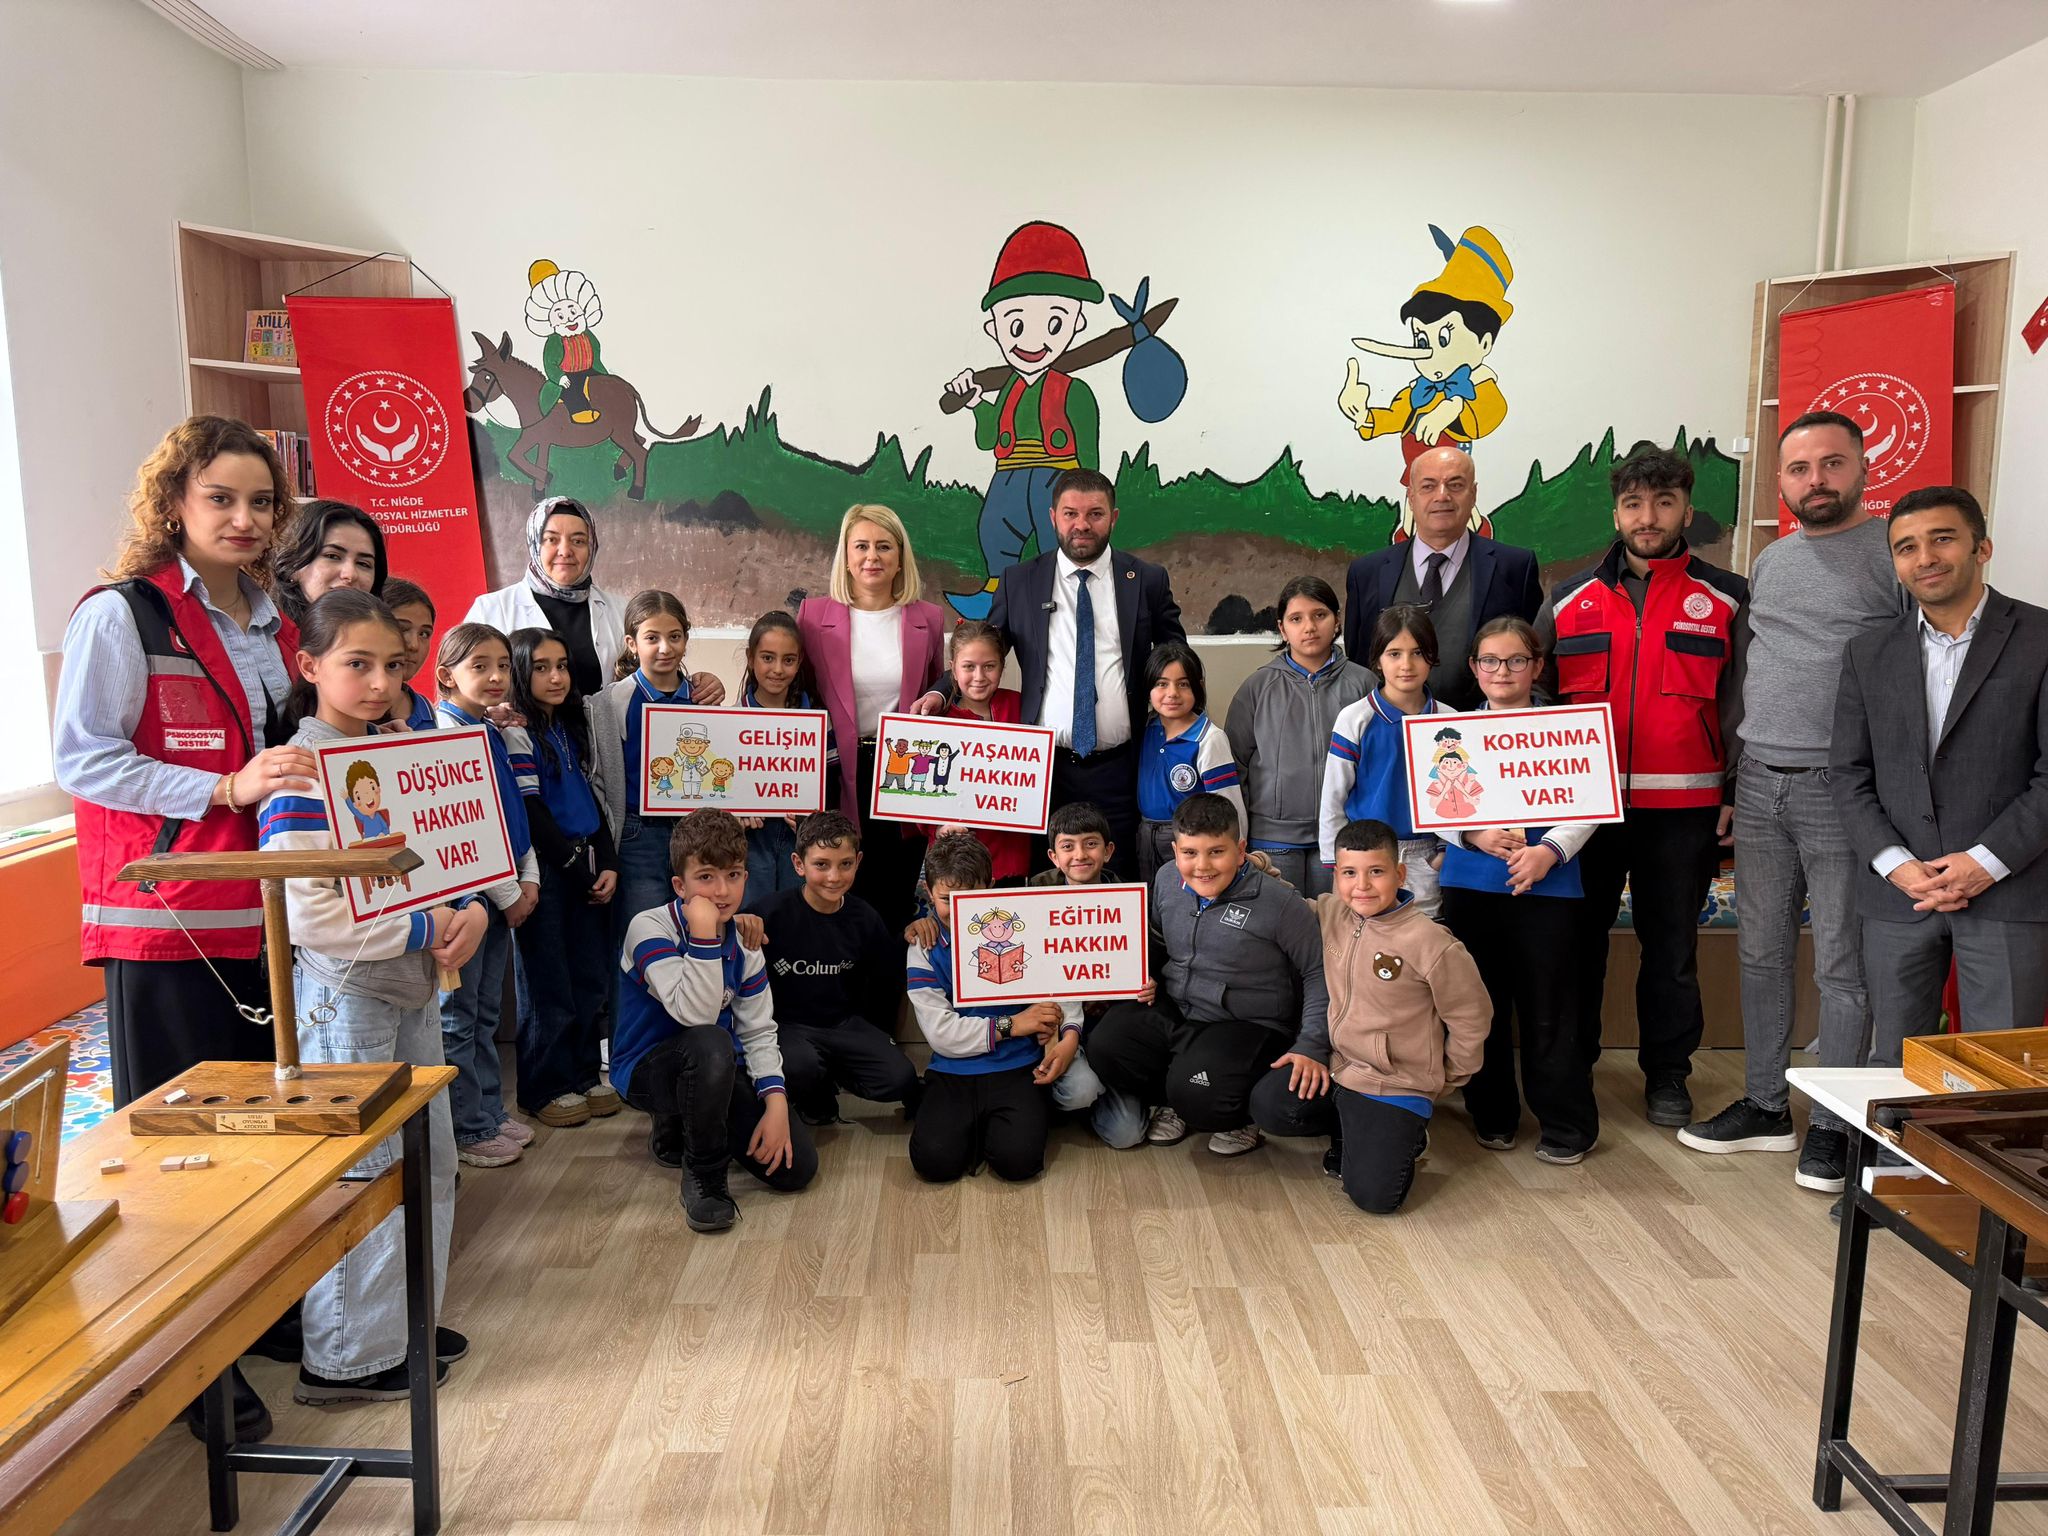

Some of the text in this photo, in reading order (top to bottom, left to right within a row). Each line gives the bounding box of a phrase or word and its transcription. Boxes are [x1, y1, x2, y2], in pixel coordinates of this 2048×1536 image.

[370, 495, 424, 507] T.C. NİĞDE
[1861, 499, 1891, 511] İĞDE
[369, 508, 469, 521] SOSYAL HİZMETLER
[381, 521, 441, 534] ÜDÜRLÜĞÜ
[738, 727, 816, 750] GELİŞİM
[1483, 728, 1601, 751] KORUNMA
[960, 741, 1041, 763] YAŞAMA
[738, 756, 816, 773] HAKKIM
[1499, 757, 1591, 778] HAKKIM
[397, 759, 484, 796] DÜŞÜNCE
[960, 767, 1036, 788] HAKKIM
[755, 782, 799, 798] VAR!
[1521, 787, 1574, 806] VAR!
[975, 794, 1018, 813] VAR!
[412, 798, 485, 835] HAKKIM
[436, 840, 479, 871] VAR!
[1049, 904, 1122, 926] EĞİTİM
[1043, 935, 1128, 954] HAKKIM
[1062, 962, 1110, 980] VAR!
[1189, 1077, 1211, 1087] adidas
